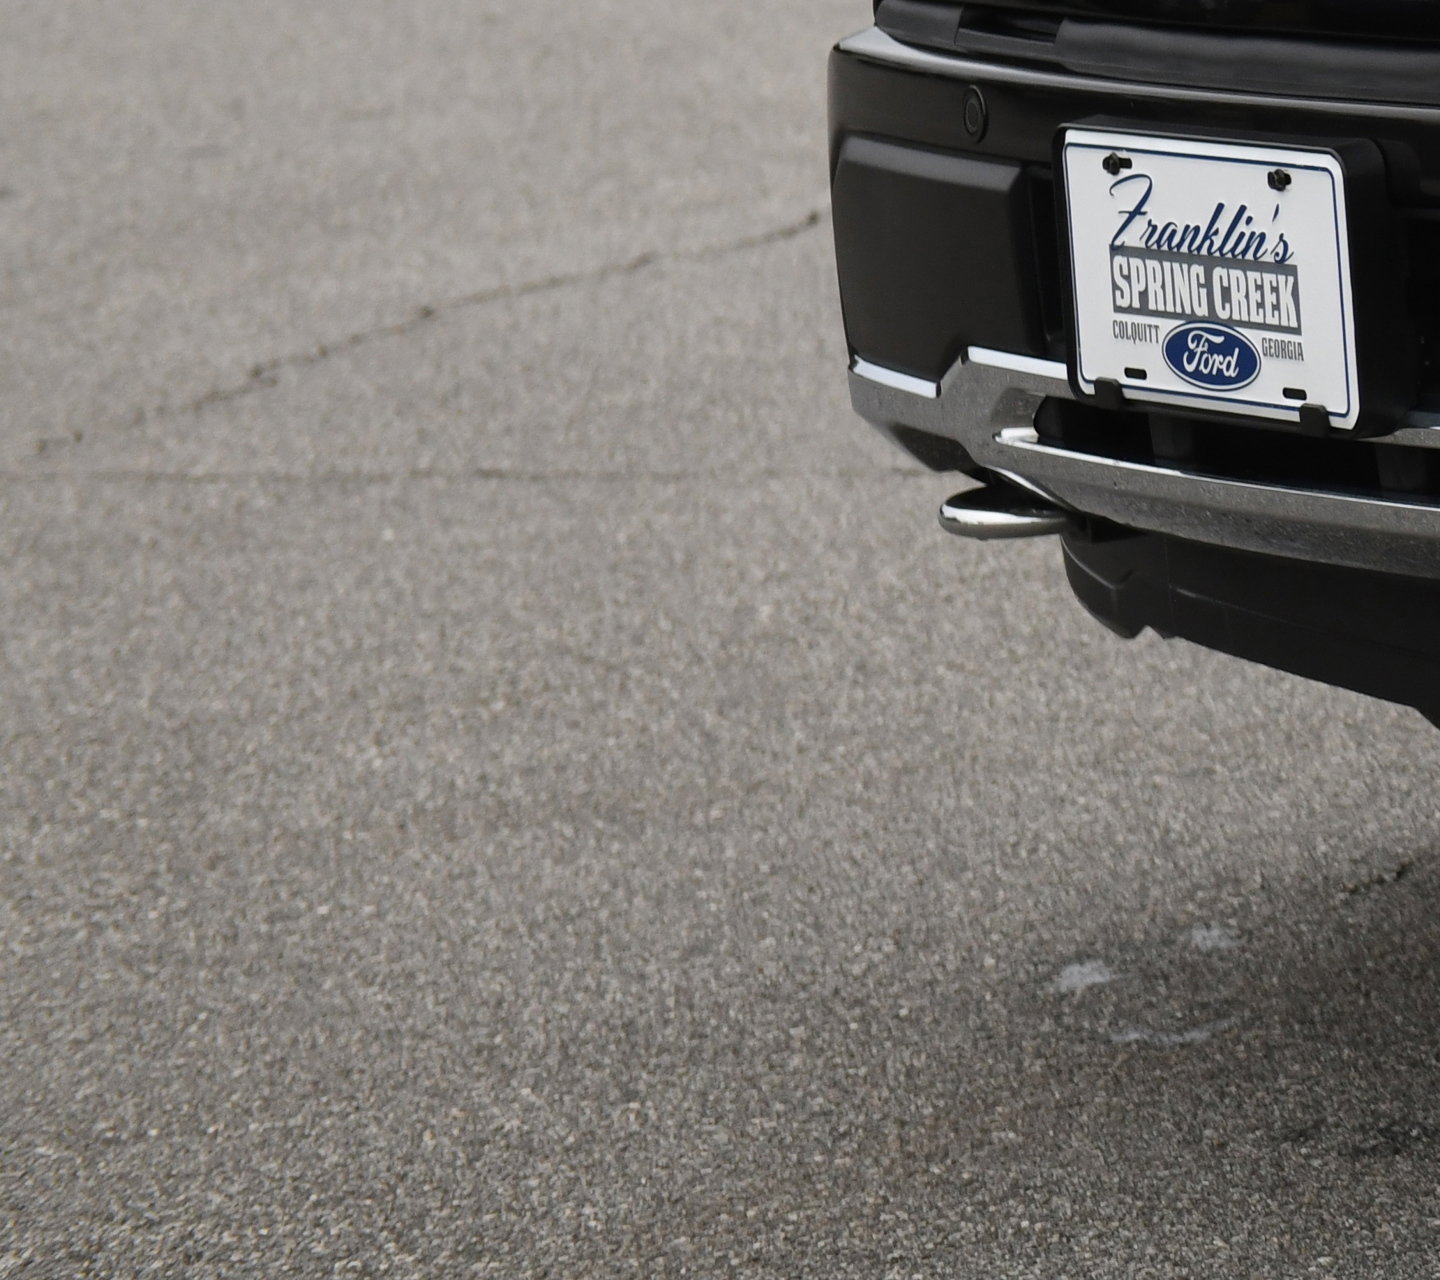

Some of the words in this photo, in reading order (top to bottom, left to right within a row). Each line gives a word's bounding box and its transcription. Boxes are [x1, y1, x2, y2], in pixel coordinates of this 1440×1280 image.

[1109, 173, 1294, 265] Franklin's
[1112, 254, 1207, 317] SPRING
[1212, 266, 1298, 329] CREEK
[1112, 319, 1160, 344] COLQUITT
[1183, 329, 1240, 379] Ford
[1261, 337, 1304, 362] GEORGIA
